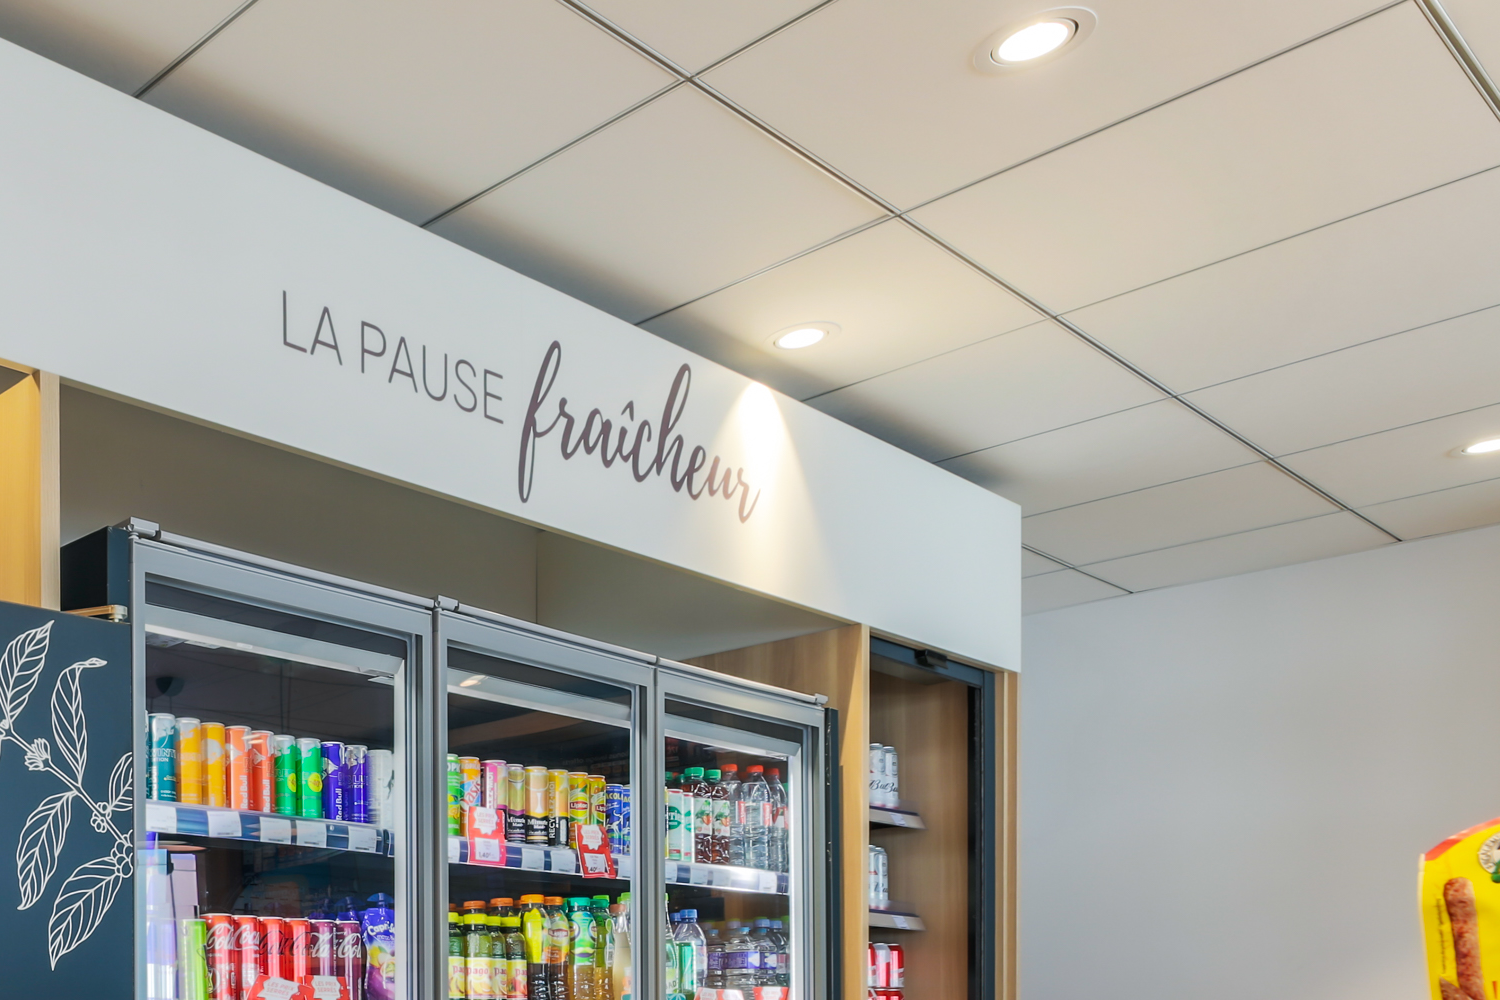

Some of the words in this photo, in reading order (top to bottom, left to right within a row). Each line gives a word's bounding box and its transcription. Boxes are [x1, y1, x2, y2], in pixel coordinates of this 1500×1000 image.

[282, 290, 342, 366] LA
[360, 321, 504, 424] PAUSE
[518, 340, 761, 524] fraîcheur
